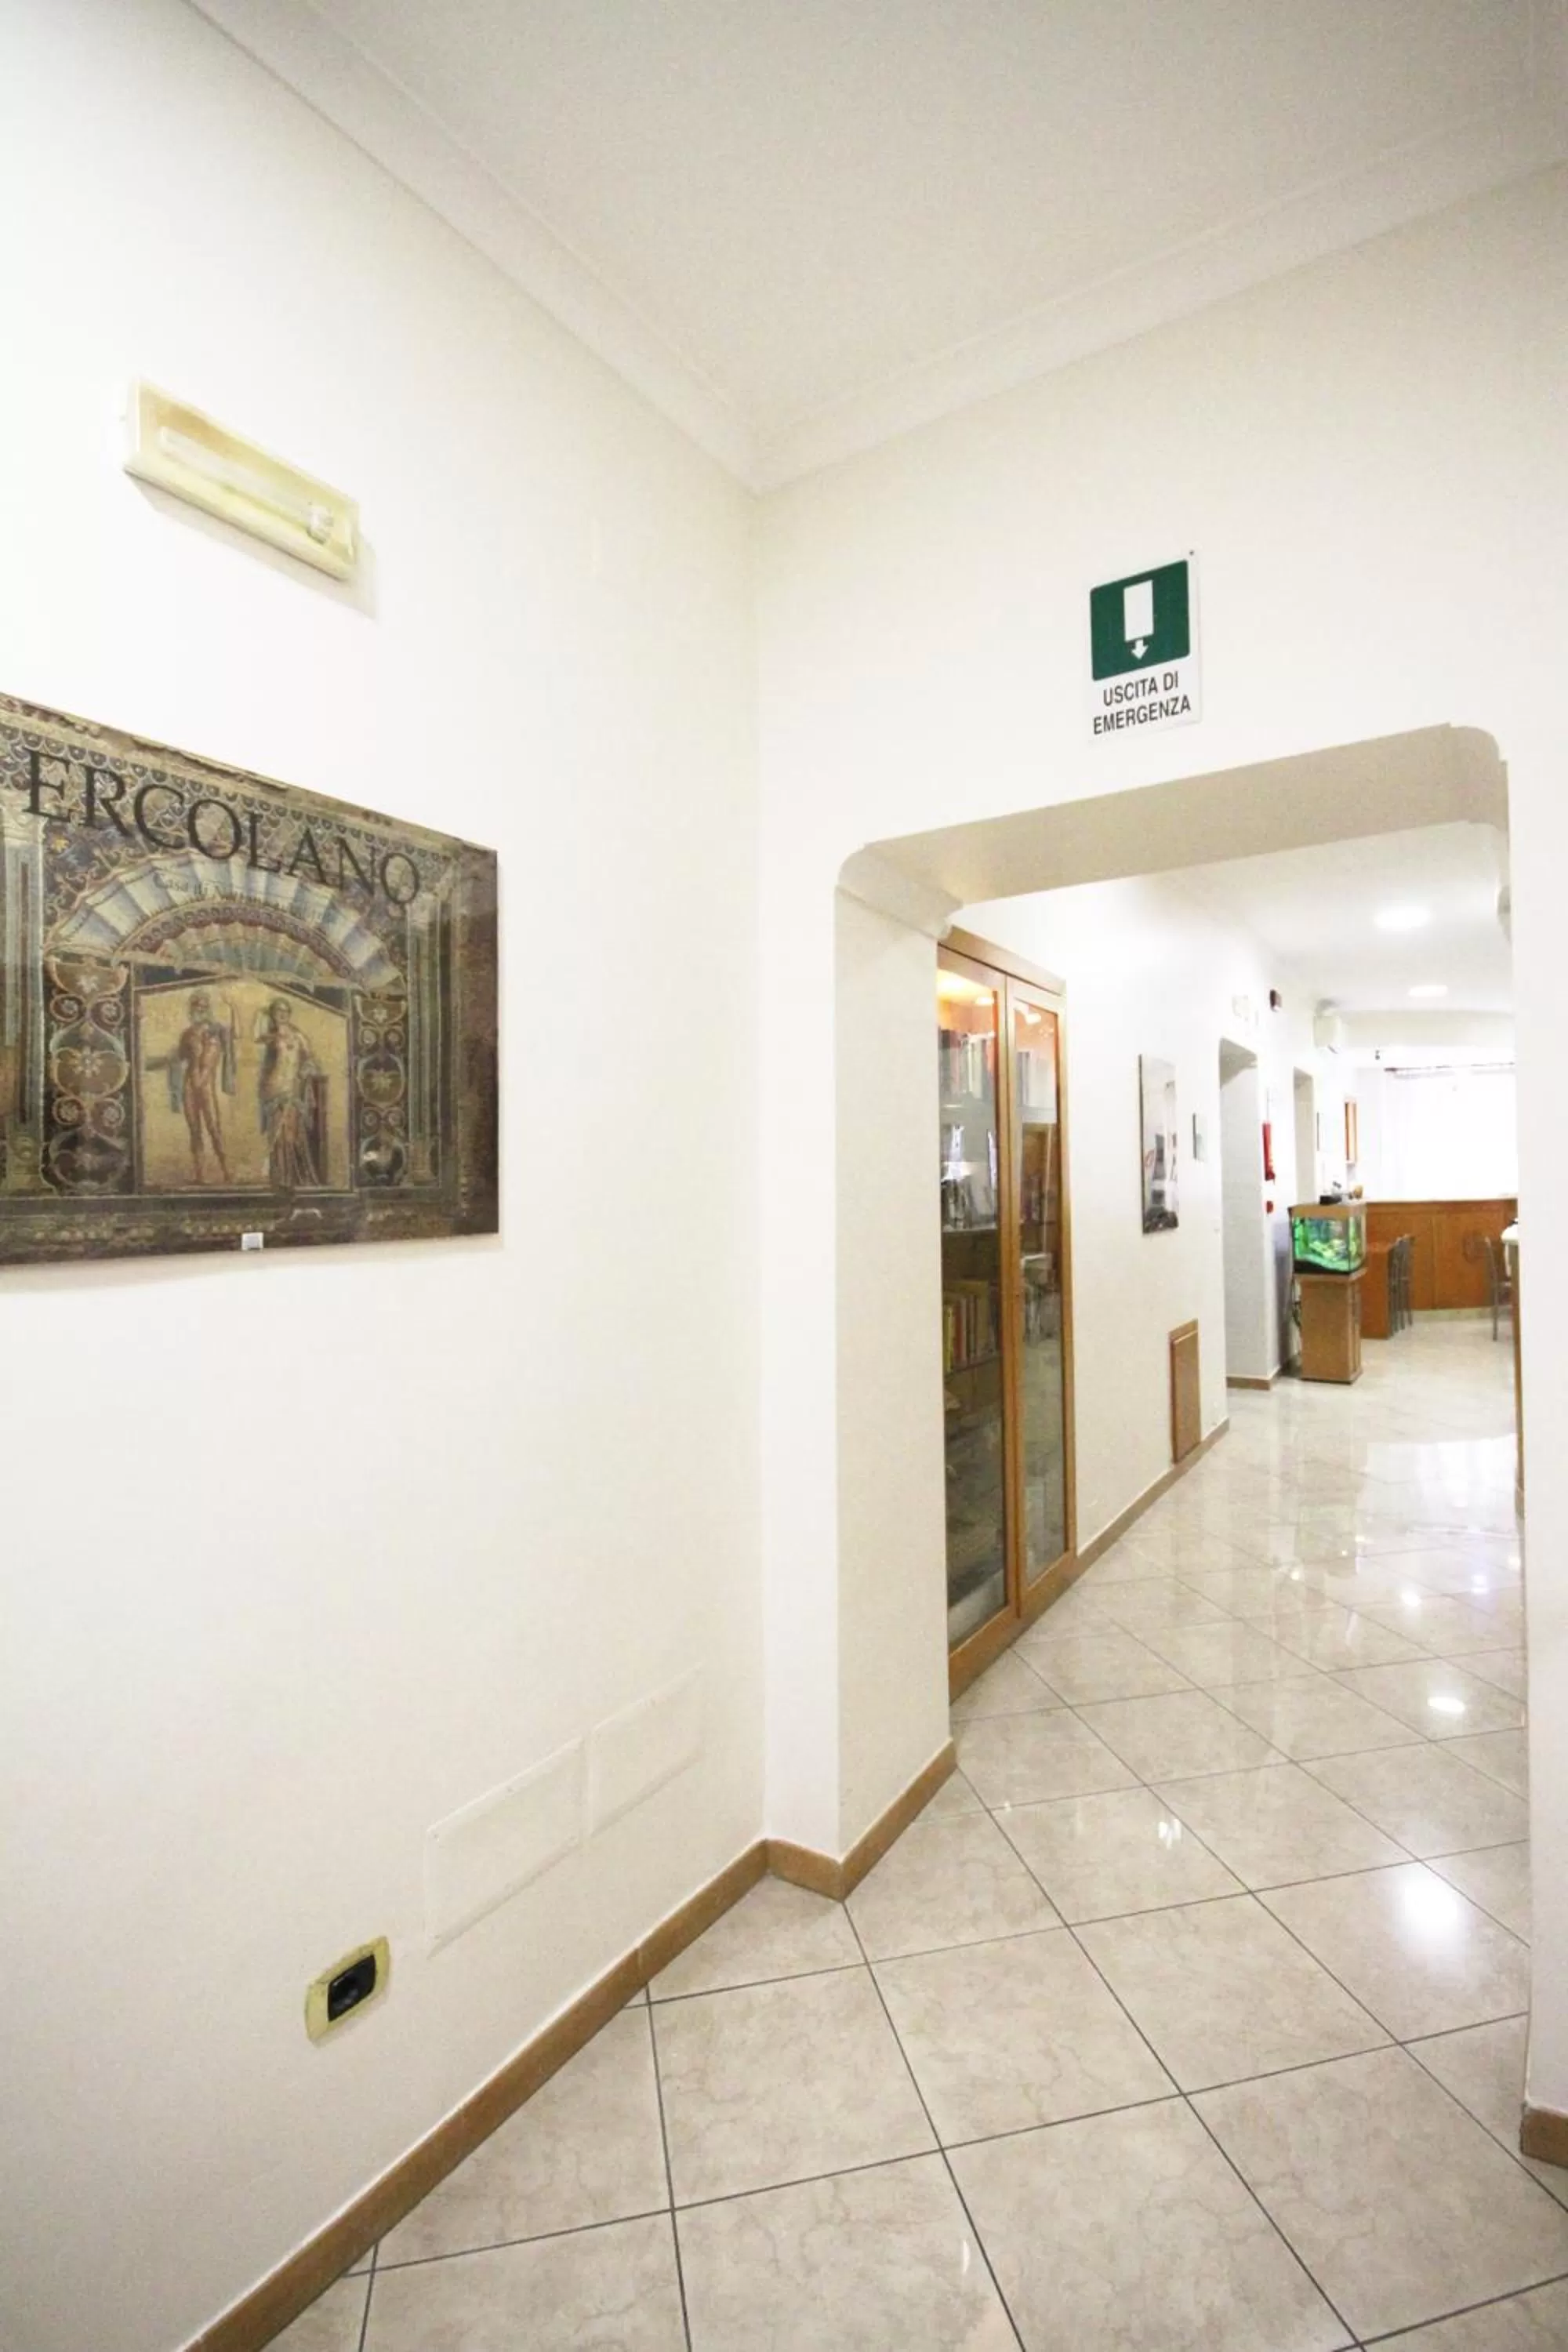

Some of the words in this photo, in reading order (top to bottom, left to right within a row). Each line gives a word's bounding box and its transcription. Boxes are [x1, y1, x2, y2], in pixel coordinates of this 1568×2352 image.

[1103, 677, 1158, 706] USCITA
[1163, 670, 1178, 691] DI
[1093, 695, 1191, 735] EMERGENZA
[23, 748, 420, 905] ERCOLANO
